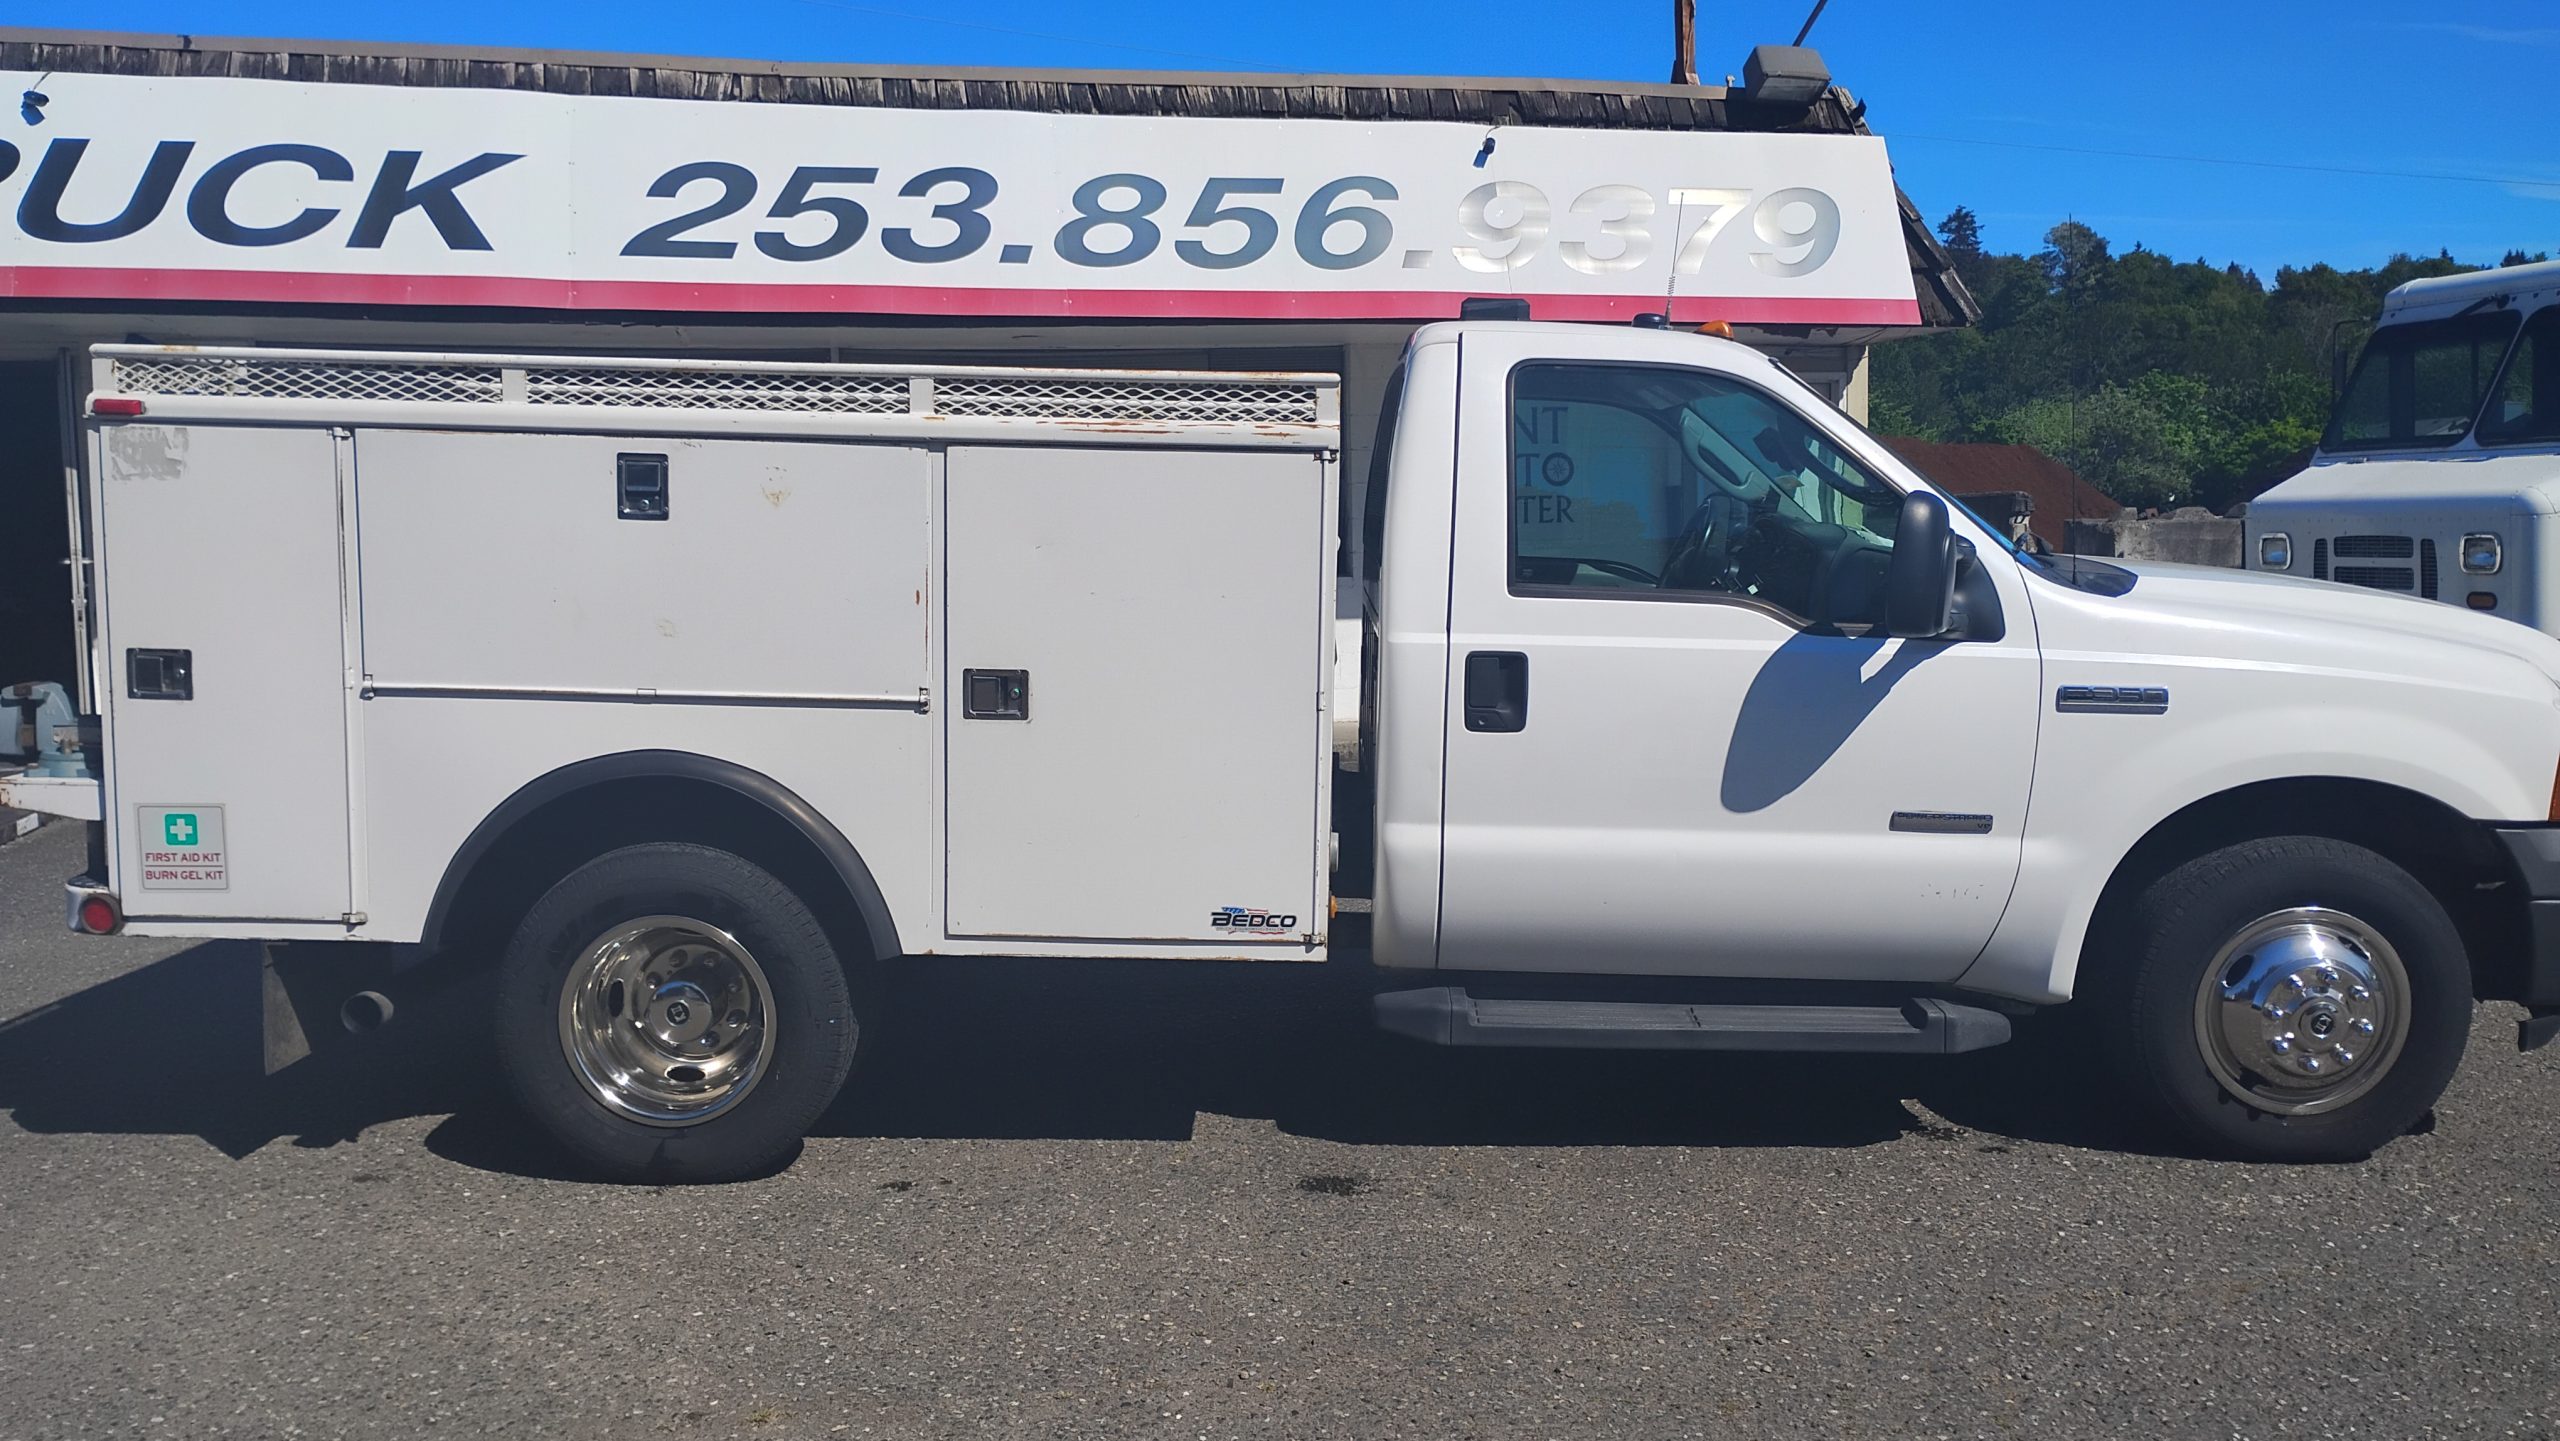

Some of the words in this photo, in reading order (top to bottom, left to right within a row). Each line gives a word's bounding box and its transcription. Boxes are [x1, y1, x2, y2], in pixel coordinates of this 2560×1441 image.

[0, 137, 528, 252] UCK
[618, 161, 1842, 279] 253.856.9379
[145, 852, 178, 862] FIRST
[180, 852, 201, 862] AID
[202, 852, 221, 862] KIT
[145, 870, 178, 881] BURN
[180, 870, 203, 880] GEL
[205, 870, 224, 880] KIT
[1211, 912, 1297, 927] BEDCO
